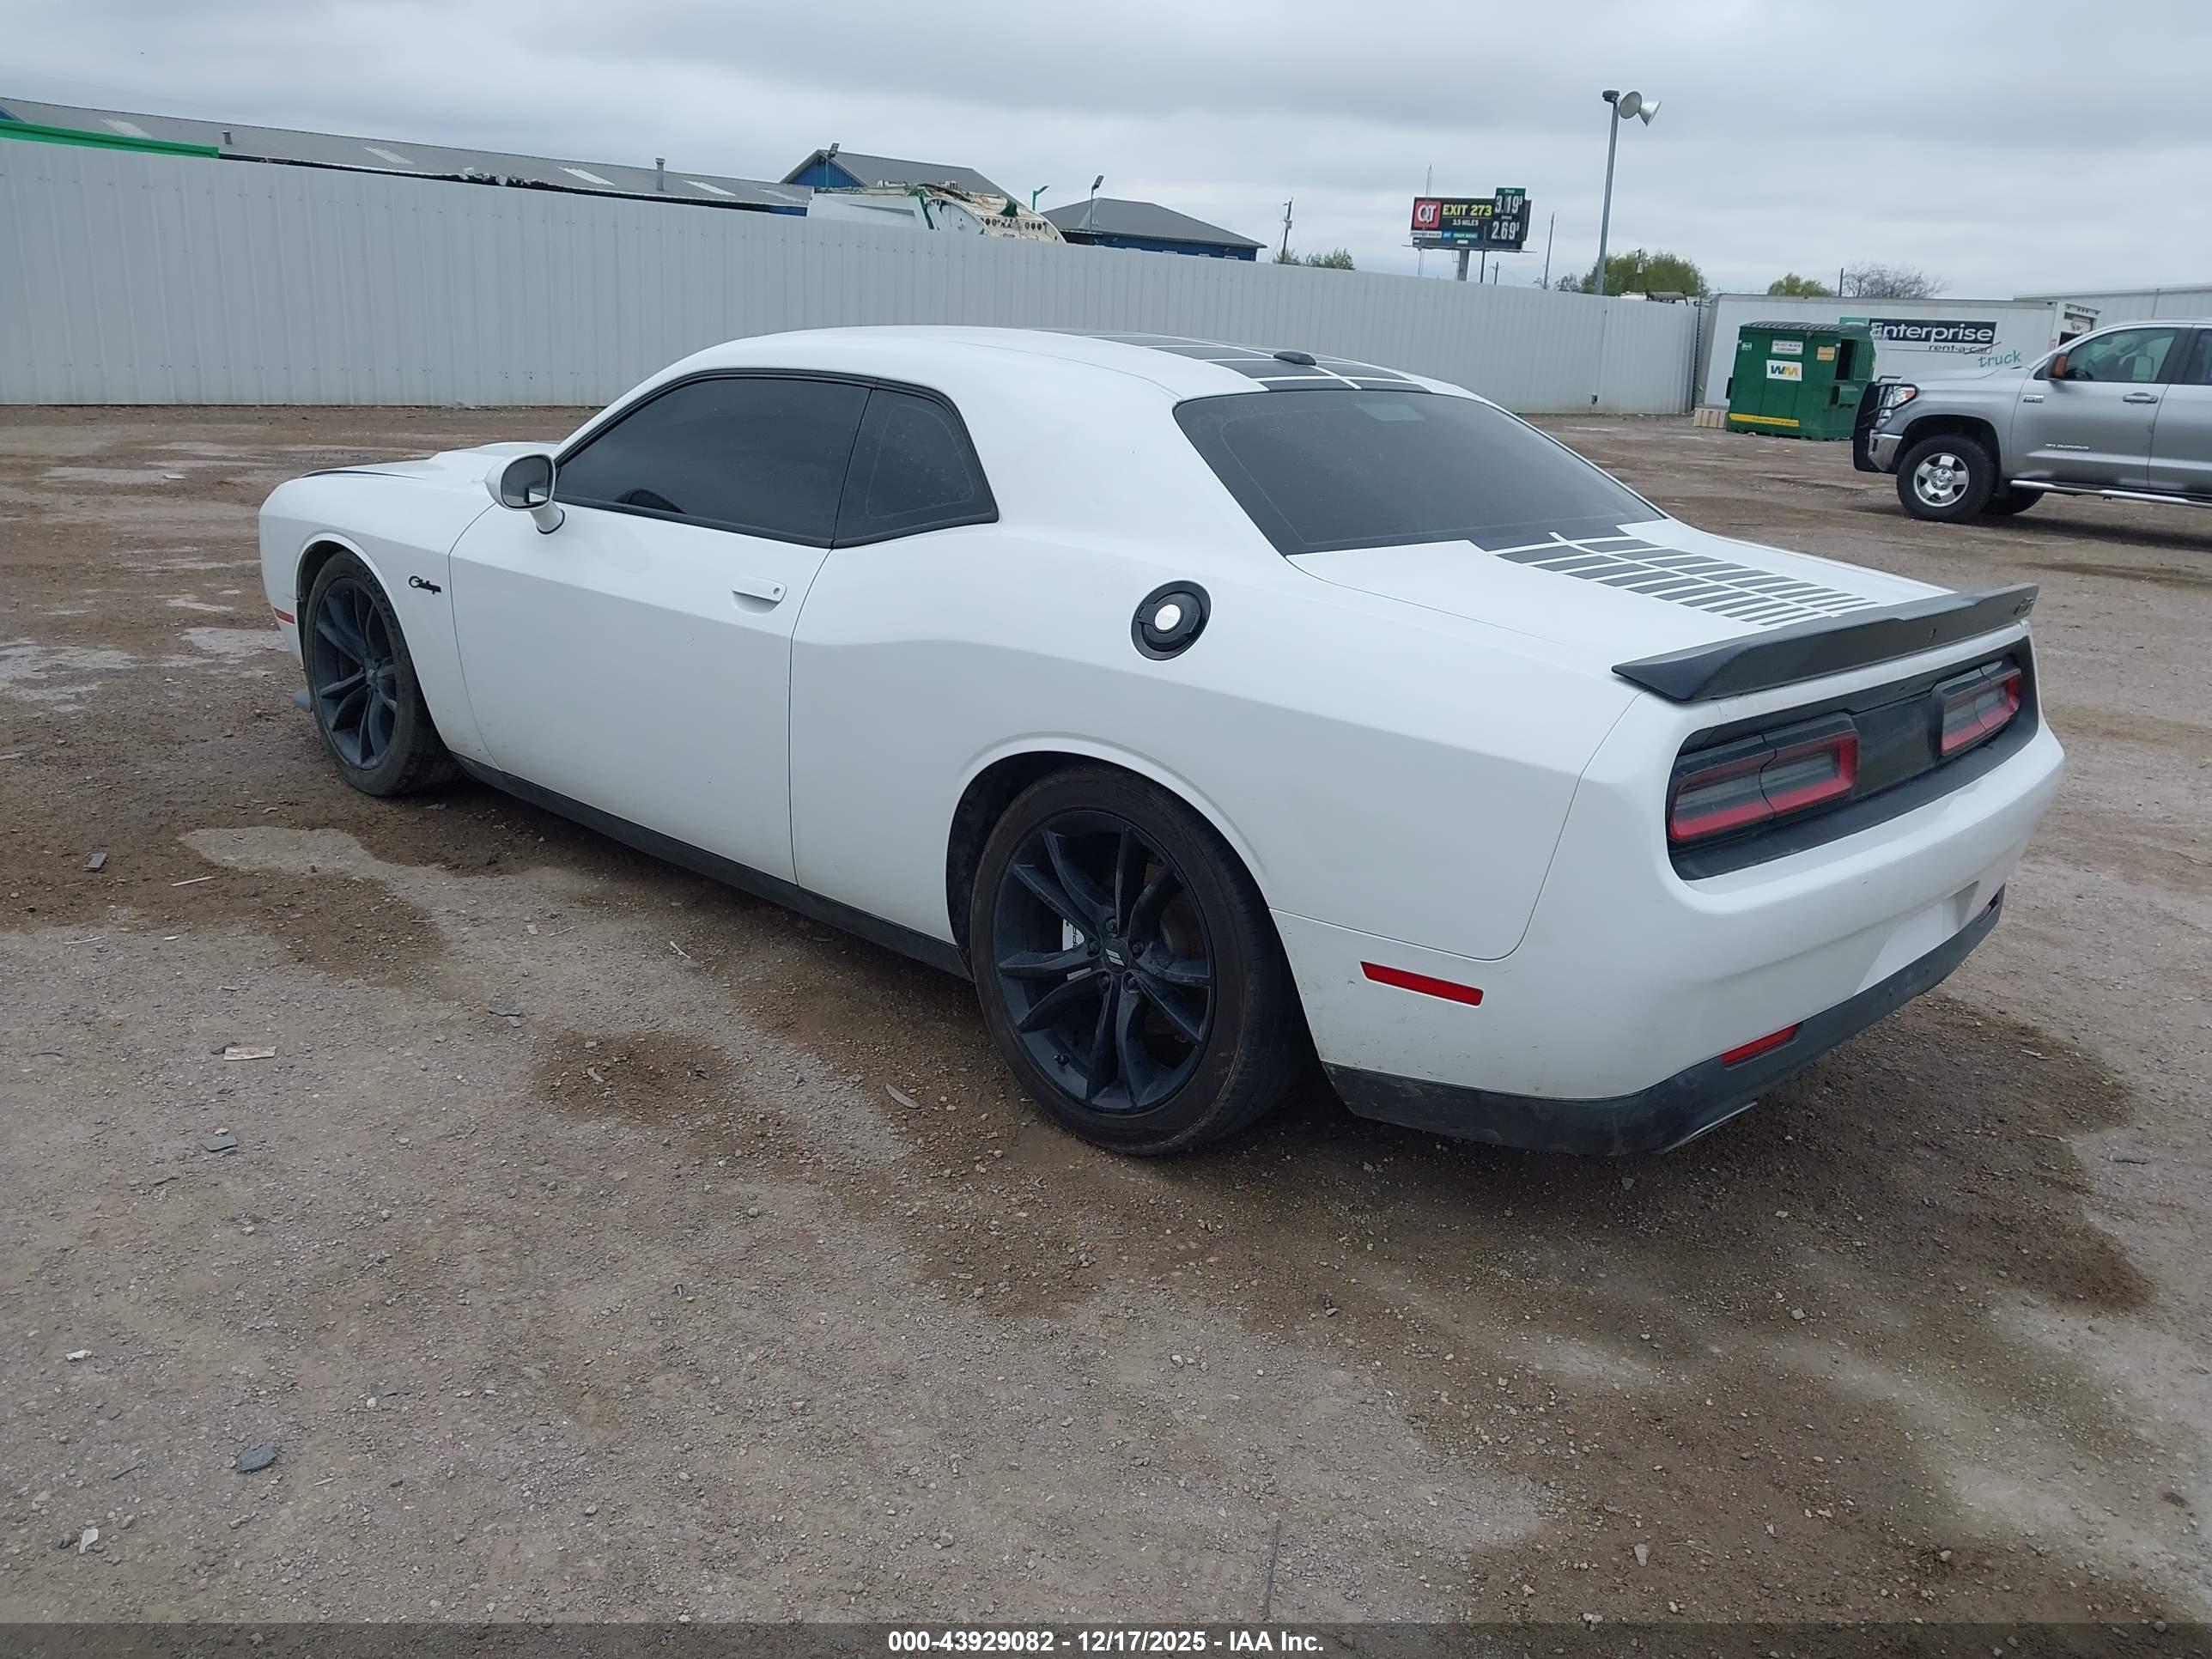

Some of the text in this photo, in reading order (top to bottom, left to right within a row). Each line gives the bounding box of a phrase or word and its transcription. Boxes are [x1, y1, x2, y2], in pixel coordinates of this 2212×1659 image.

[1417, 204, 1437, 223] QT
[1443, 204, 1492, 216] EXIT 273
[1978, 350, 2021, 368] truck
[1771, 365, 1798, 376] WM
